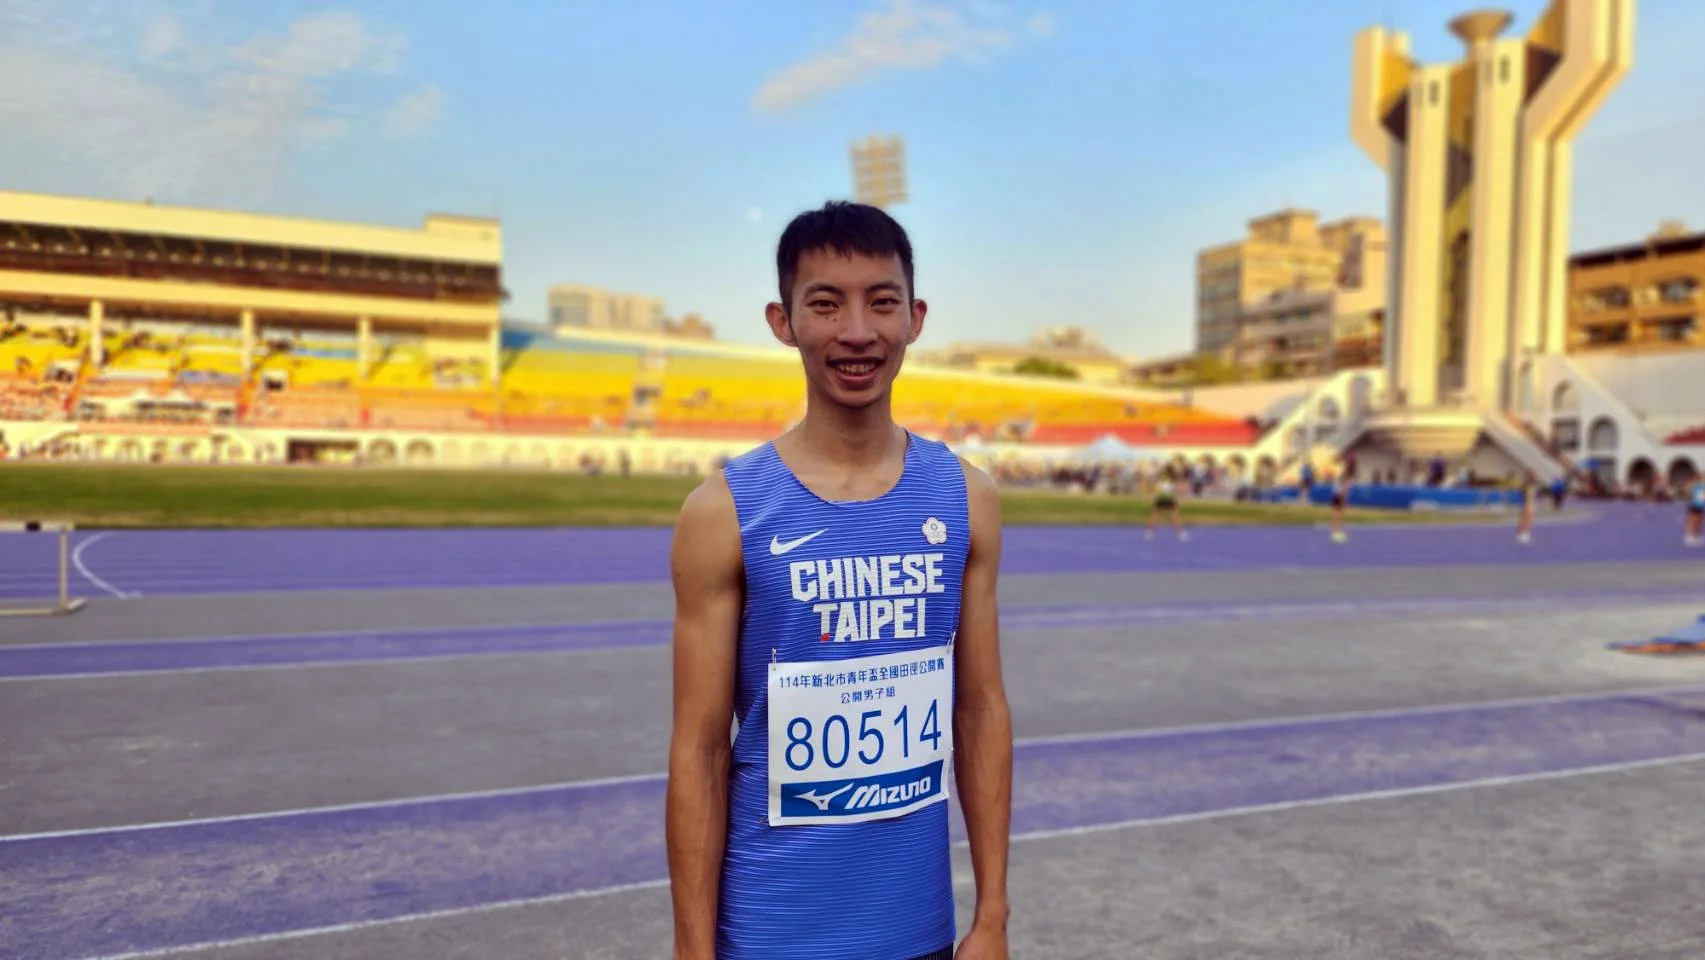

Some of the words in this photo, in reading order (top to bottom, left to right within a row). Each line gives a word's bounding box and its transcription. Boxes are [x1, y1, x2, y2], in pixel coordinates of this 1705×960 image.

[790, 553, 945, 602] CHINESE
[813, 598, 926, 642] TAIPEI
[779, 657, 945, 688] 114年新北市青年盃全國田徑公開賽
[840, 686, 896, 704] 公開男子組
[785, 699, 942, 771] 80514
